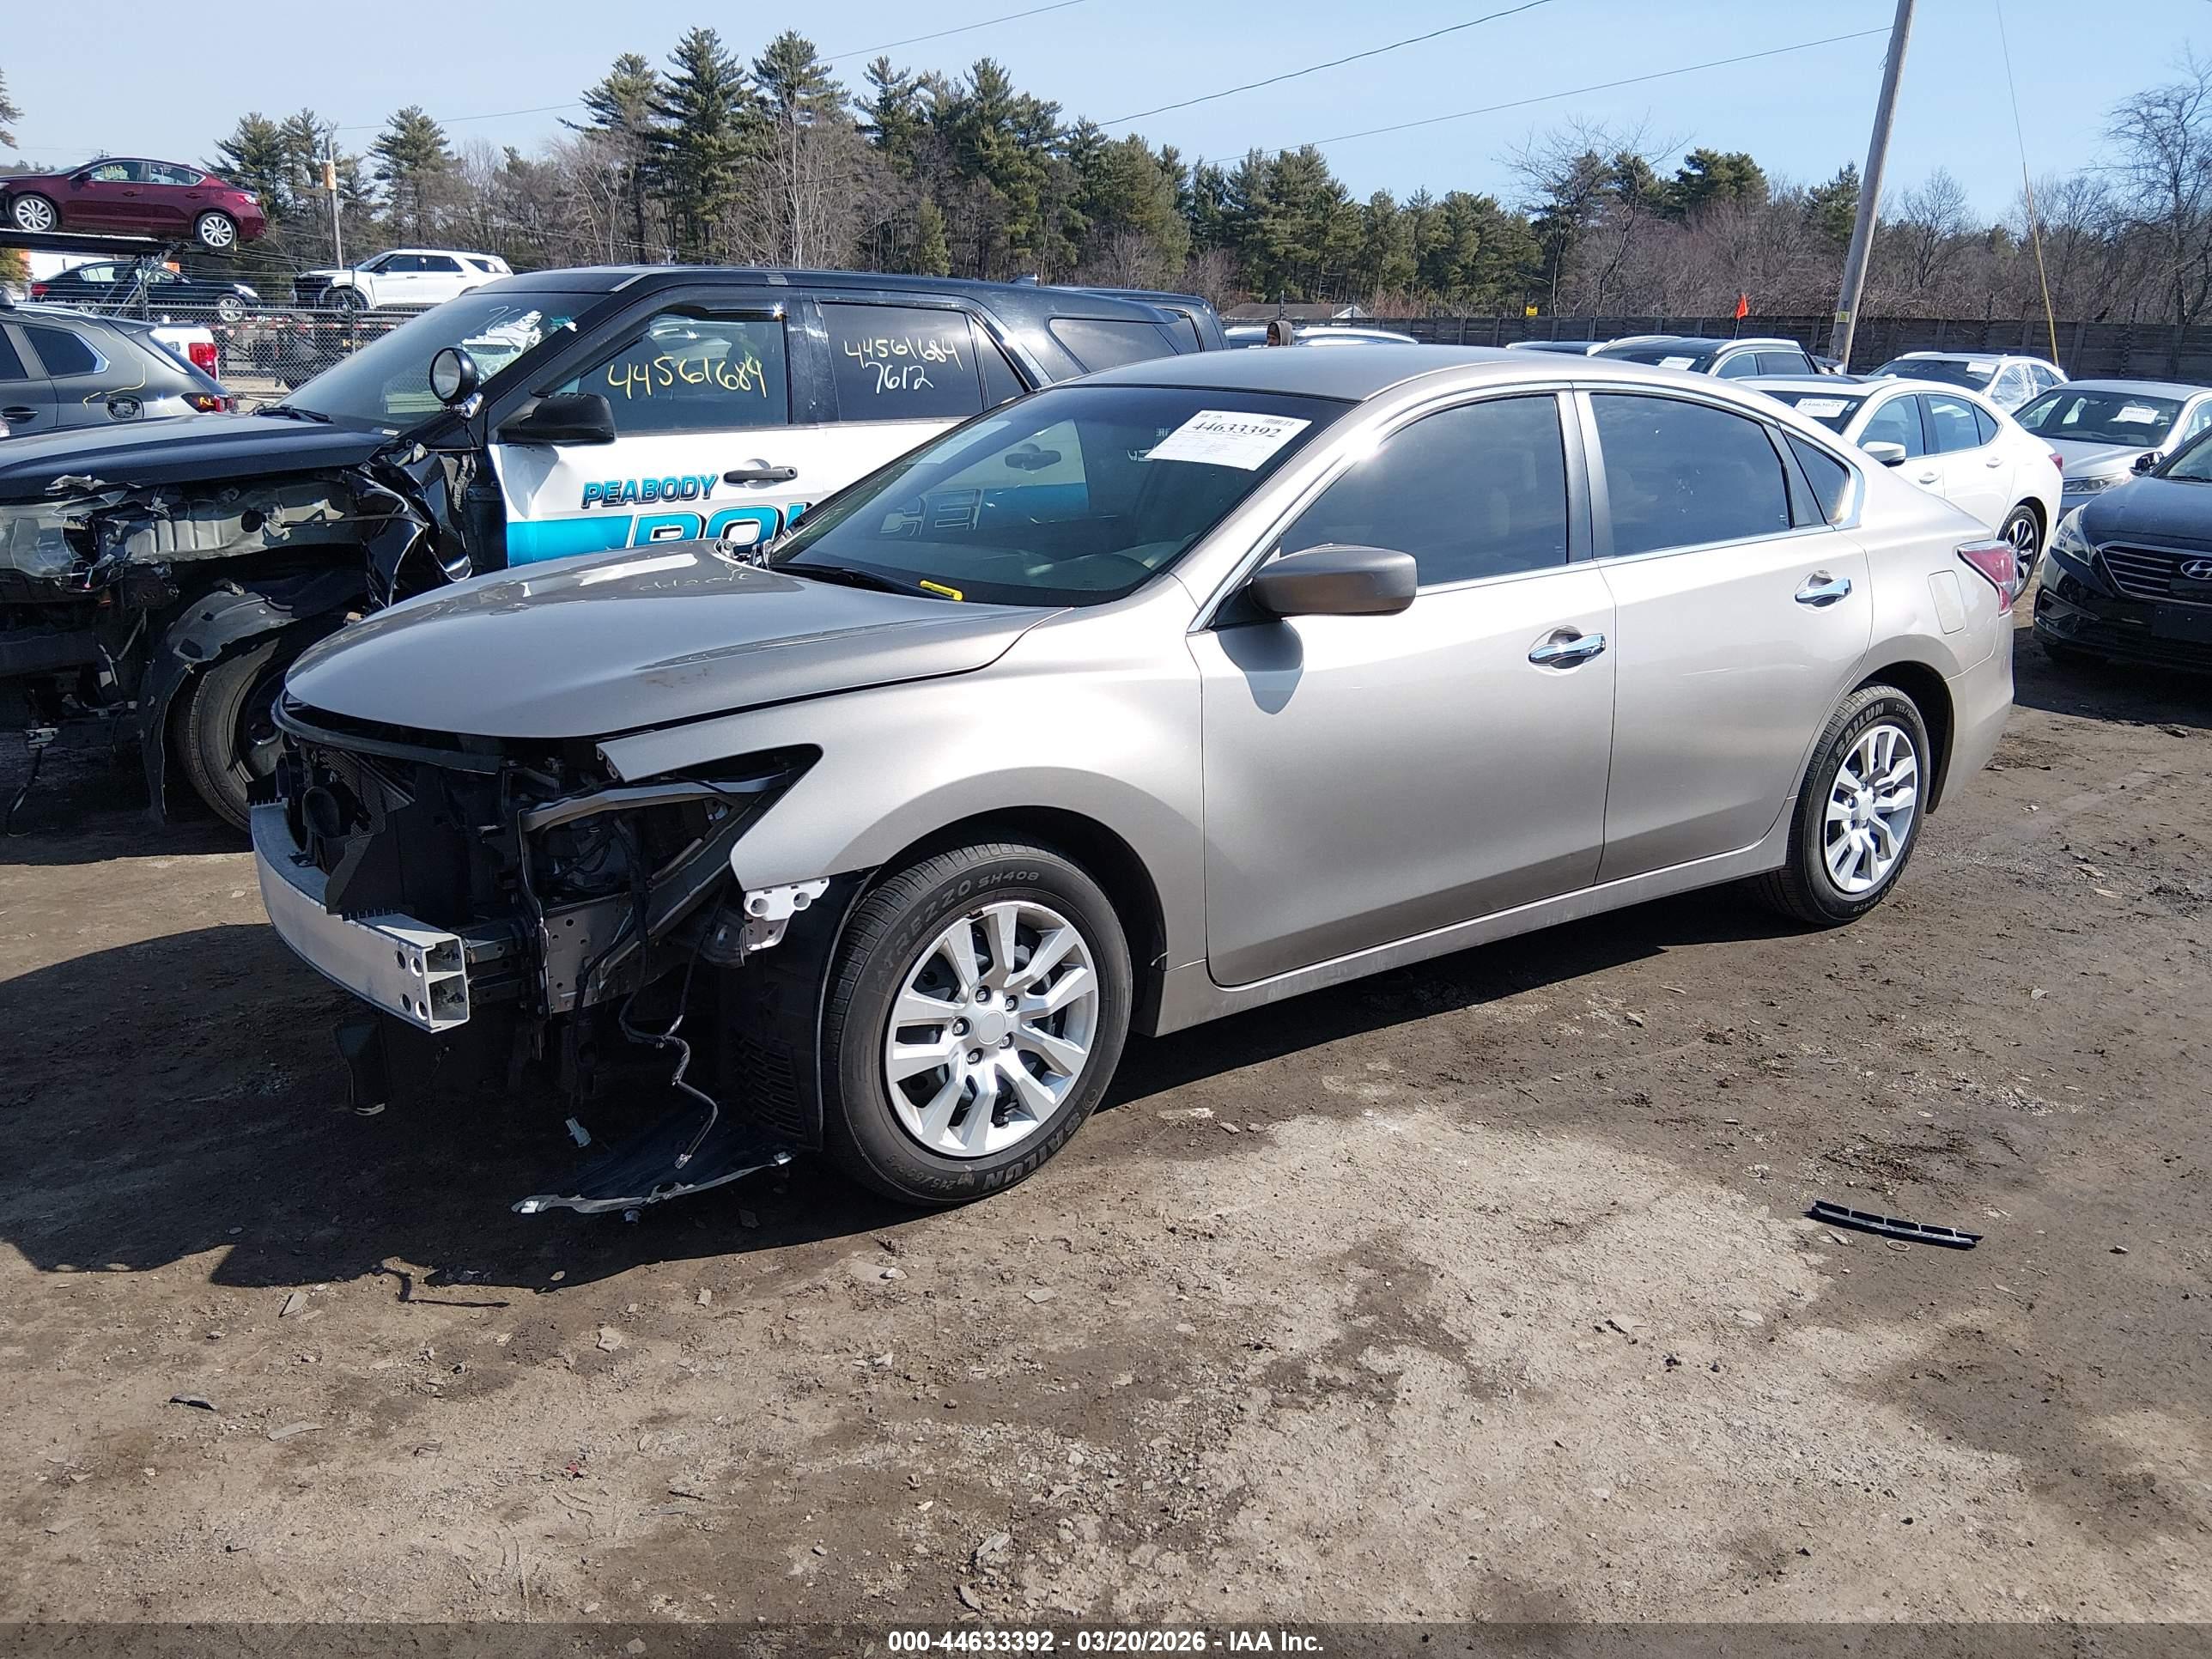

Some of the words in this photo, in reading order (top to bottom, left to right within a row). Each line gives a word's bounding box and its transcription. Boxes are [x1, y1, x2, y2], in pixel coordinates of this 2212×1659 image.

[843, 336, 963, 371] 44561684
[865, 361, 934, 394] 7612
[1193, 421, 1282, 438] 44633392
[580, 474, 719, 508] PEABODY
[1835, 702, 1885, 757] SAILUN
[977, 871, 1040, 888] SH408
